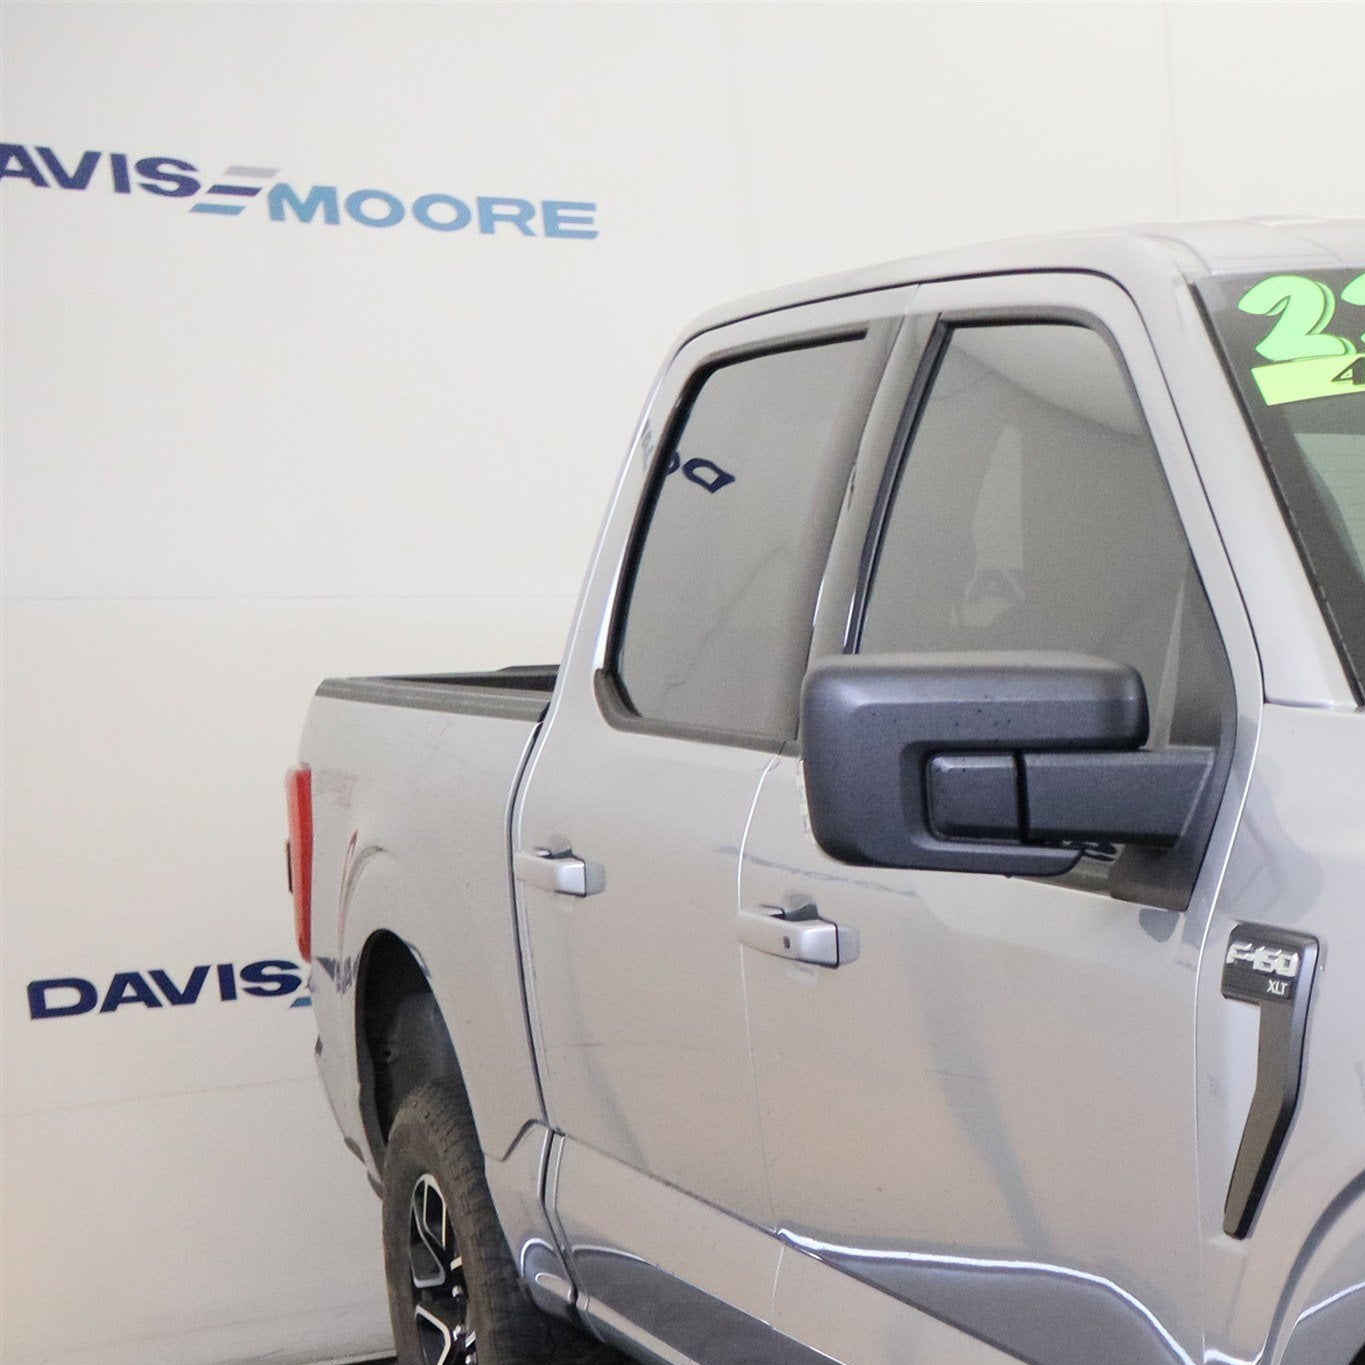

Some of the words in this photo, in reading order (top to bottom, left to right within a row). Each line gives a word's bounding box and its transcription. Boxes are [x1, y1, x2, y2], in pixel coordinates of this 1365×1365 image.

[0, 142, 202, 198] AVIS
[268, 182, 600, 240] MOORE
[1225, 941, 1300, 977] F-150
[27, 959, 303, 1020] DAVIS
[1266, 979, 1289, 995] XLT
